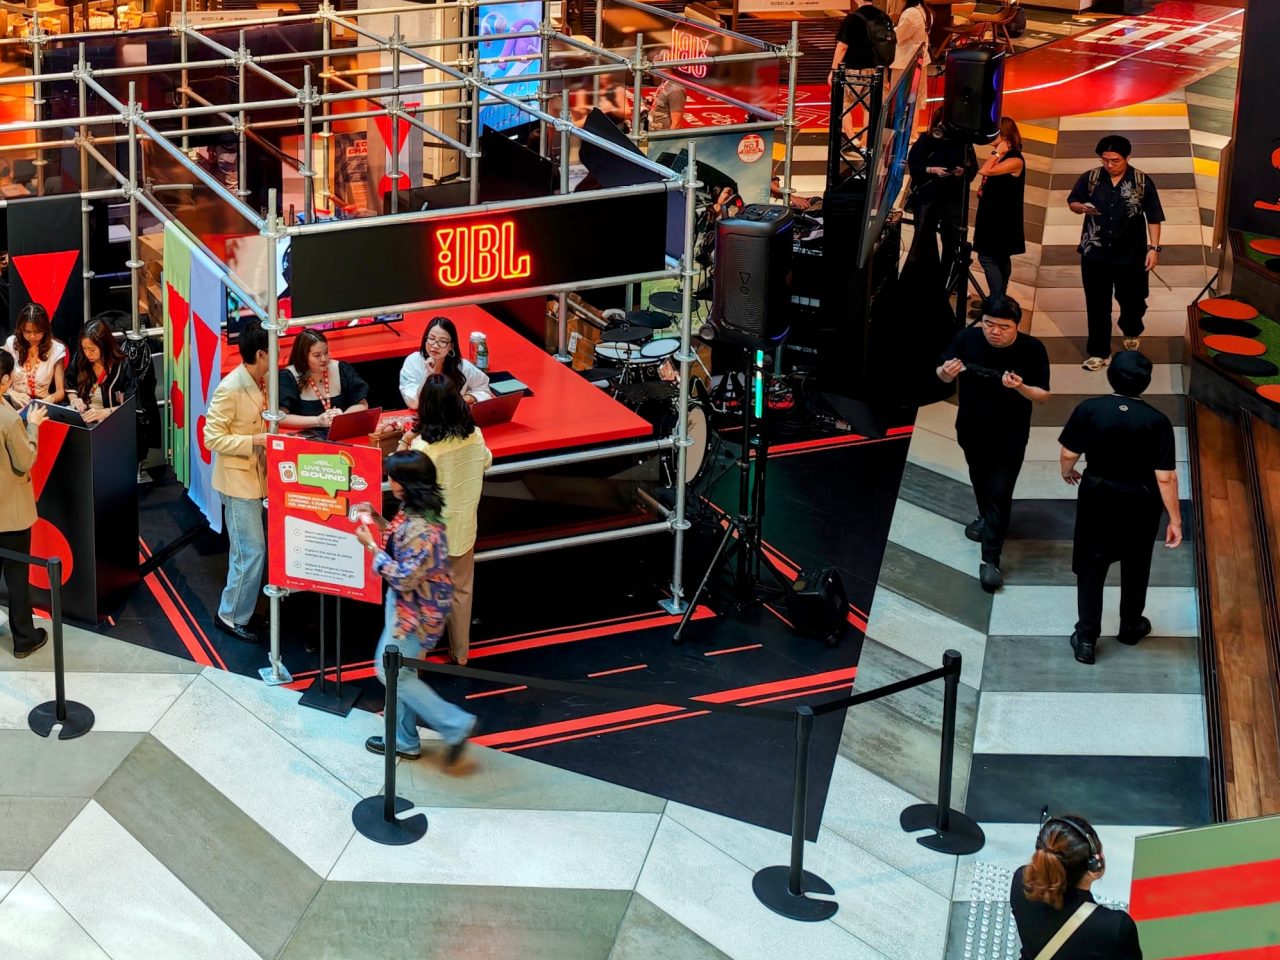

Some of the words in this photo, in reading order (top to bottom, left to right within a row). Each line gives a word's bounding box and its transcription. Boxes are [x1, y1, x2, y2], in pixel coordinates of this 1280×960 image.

[436, 221, 531, 287] JBL
[304, 464, 320, 472] LIVE
[321, 466, 343, 474] YOUR
[300, 470, 347, 482] SOUND
